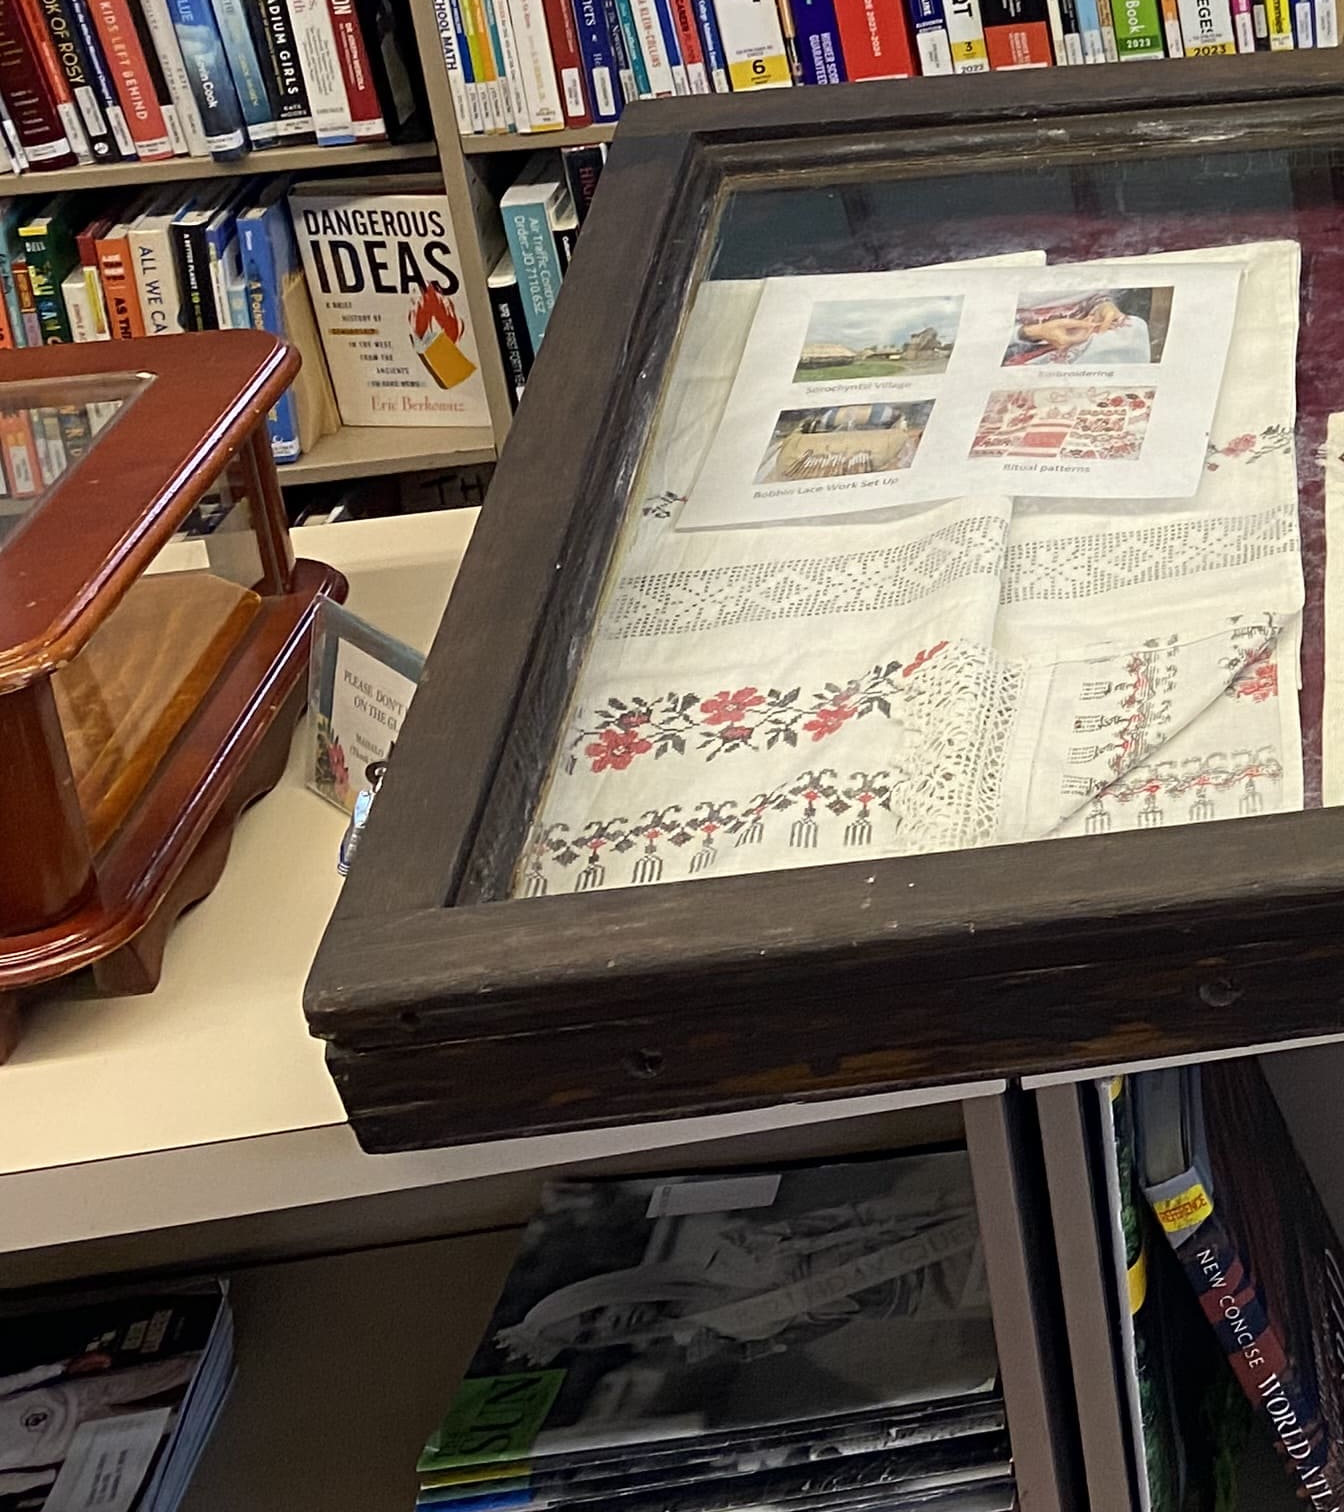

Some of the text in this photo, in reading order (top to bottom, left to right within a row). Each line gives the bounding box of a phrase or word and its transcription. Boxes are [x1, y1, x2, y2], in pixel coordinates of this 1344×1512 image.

[1126, 0, 1145, 33] Book
[304, 209, 446, 237] DANGEROUS
[310, 240, 459, 295] IDEAS
[1196, 1248, 1311, 1460] NEW CONCISE WORLD
